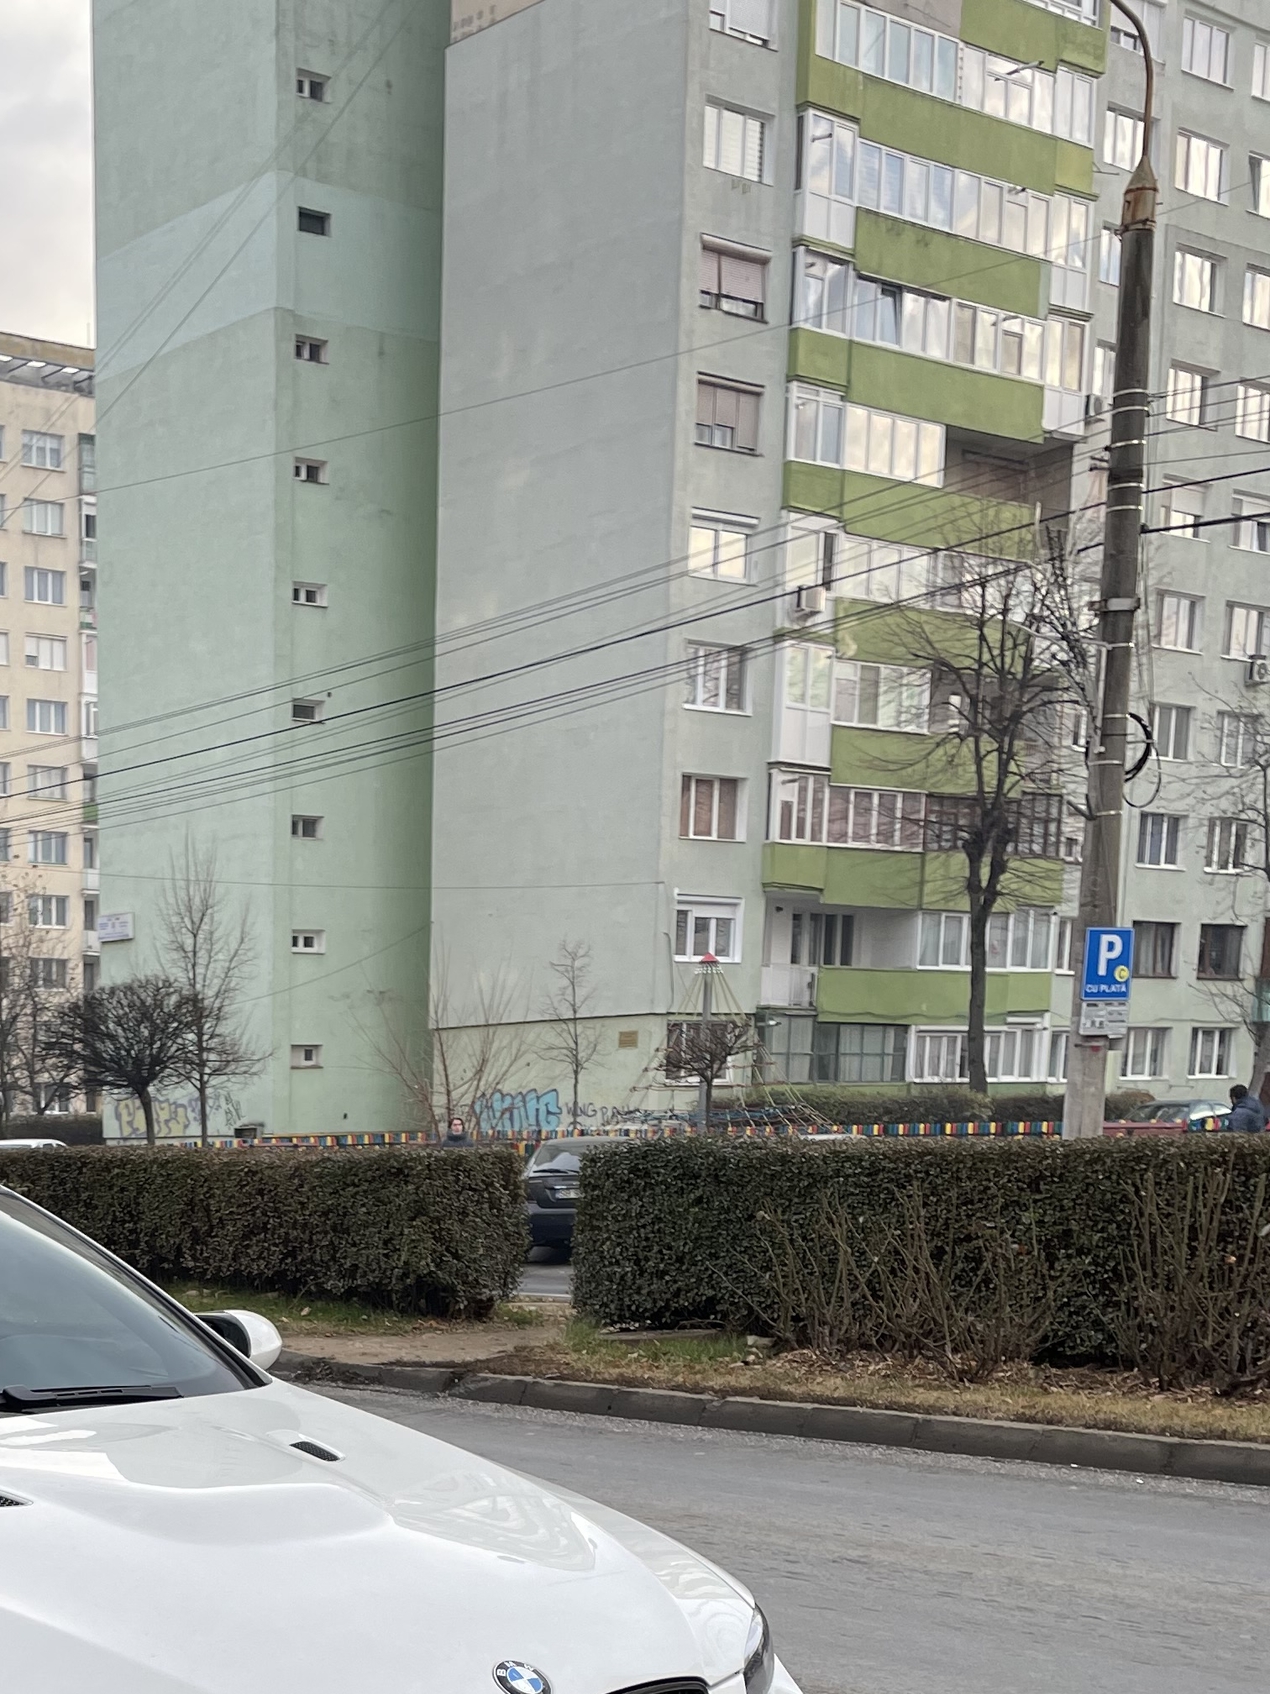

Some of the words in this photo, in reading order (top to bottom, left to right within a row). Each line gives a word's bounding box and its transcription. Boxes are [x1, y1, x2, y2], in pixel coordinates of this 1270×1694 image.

[1098, 934, 1123, 976] P
[1085, 984, 1098, 993] CU
[496, 1660, 535, 1677] BMW
